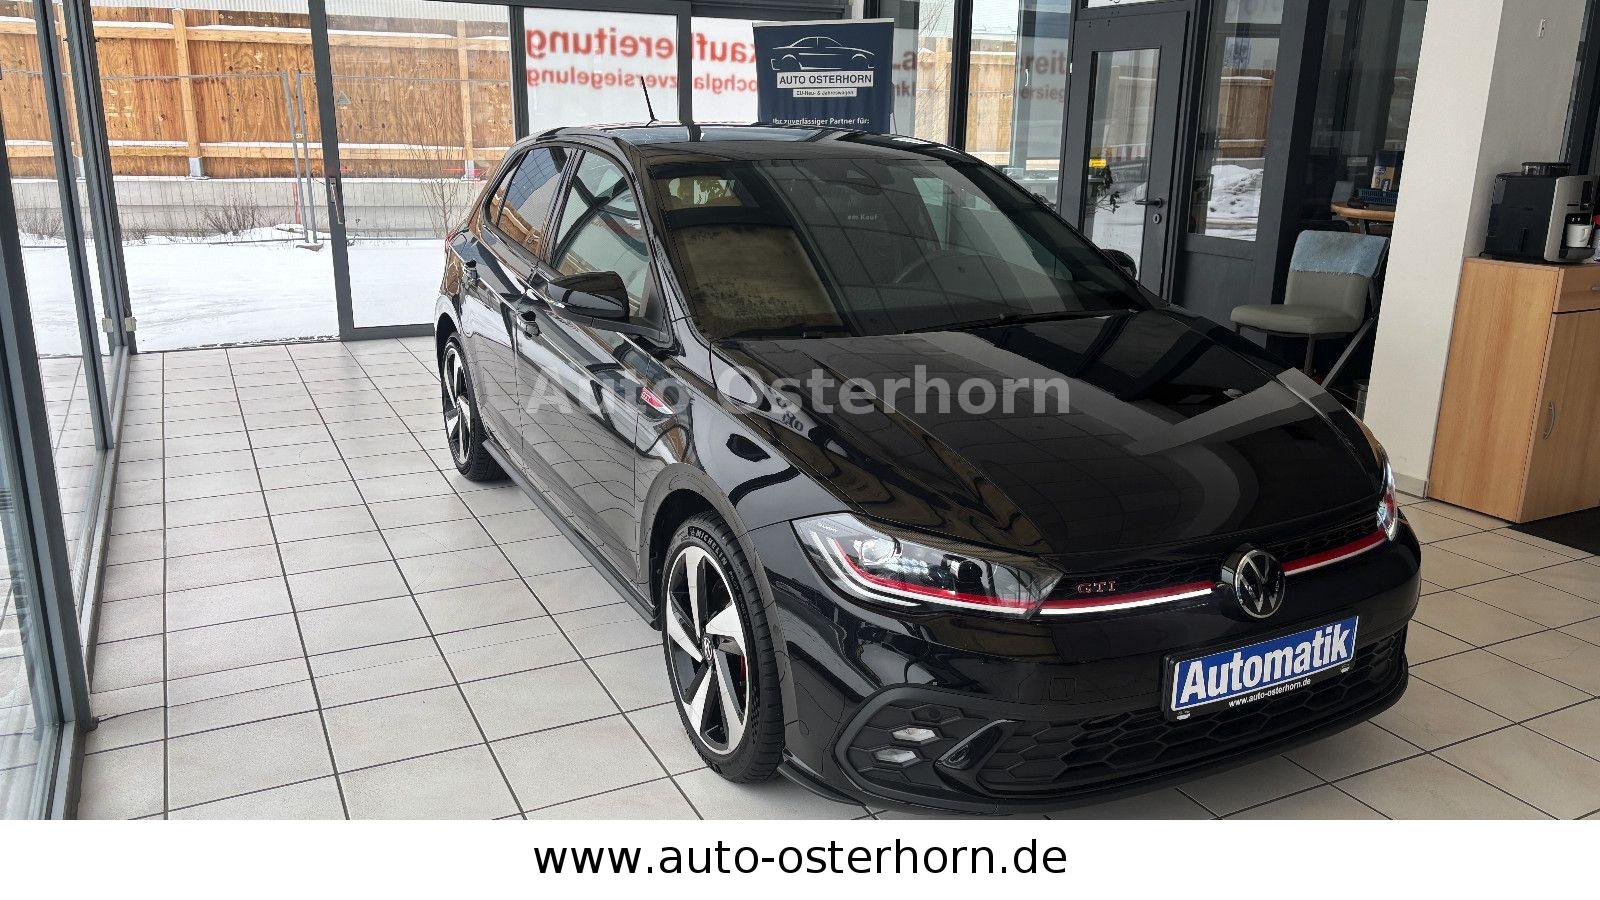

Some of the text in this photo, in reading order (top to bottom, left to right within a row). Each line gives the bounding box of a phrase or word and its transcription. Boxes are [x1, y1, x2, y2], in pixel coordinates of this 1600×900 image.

[779, 74, 872, 85] AUTO OSTERHORN
[783, 117, 828, 126] zuverlässiger
[695, 529, 728, 566] MICHELIN
[1077, 580, 1116, 594] GTI
[1180, 623, 1351, 704] Automatik
[1228, 677, 1311, 708] www.auto-osterhorn.de
